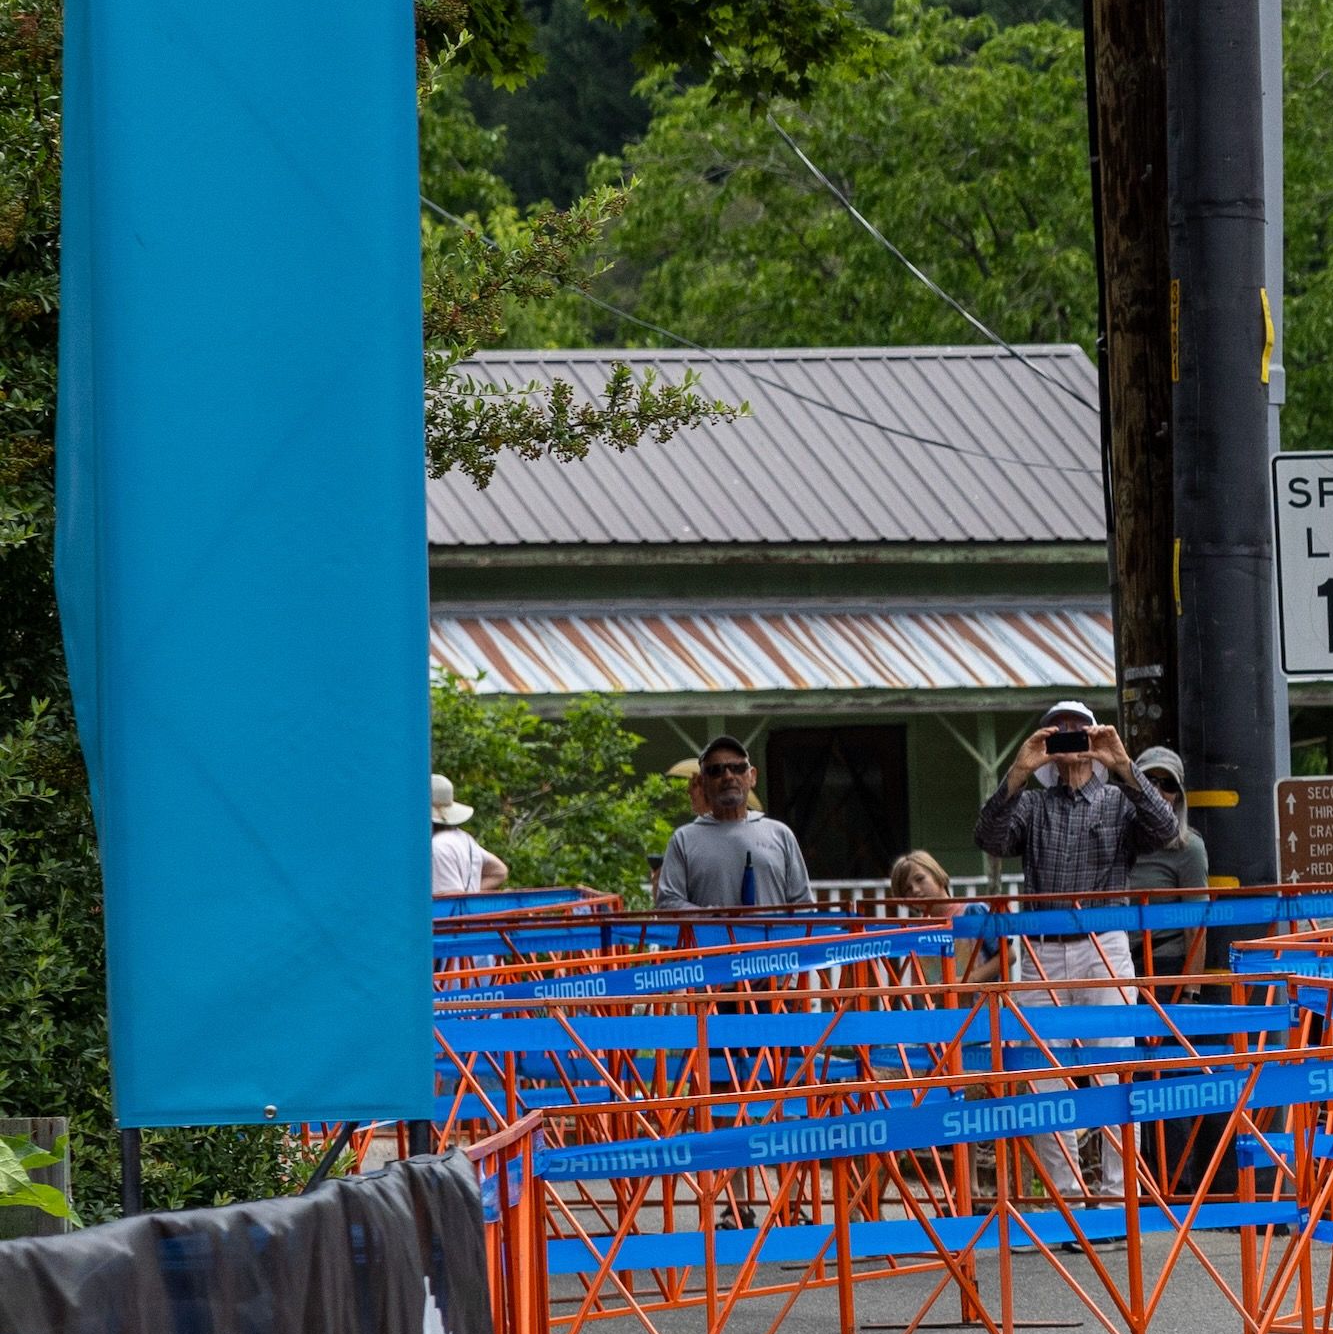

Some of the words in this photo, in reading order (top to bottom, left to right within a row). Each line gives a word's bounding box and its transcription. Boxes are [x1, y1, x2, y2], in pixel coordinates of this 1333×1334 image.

[1311, 862, 1333, 875] RED
[1263, 899, 1333, 918] SHIMANO
[634, 965, 704, 990] SHIMANO
[731, 952, 799, 977] SHIMANO
[825, 940, 892, 965] SHIMANO
[749, 1118, 886, 1159] SHIMANO
[943, 1098, 1076, 1137] SHIMANO
